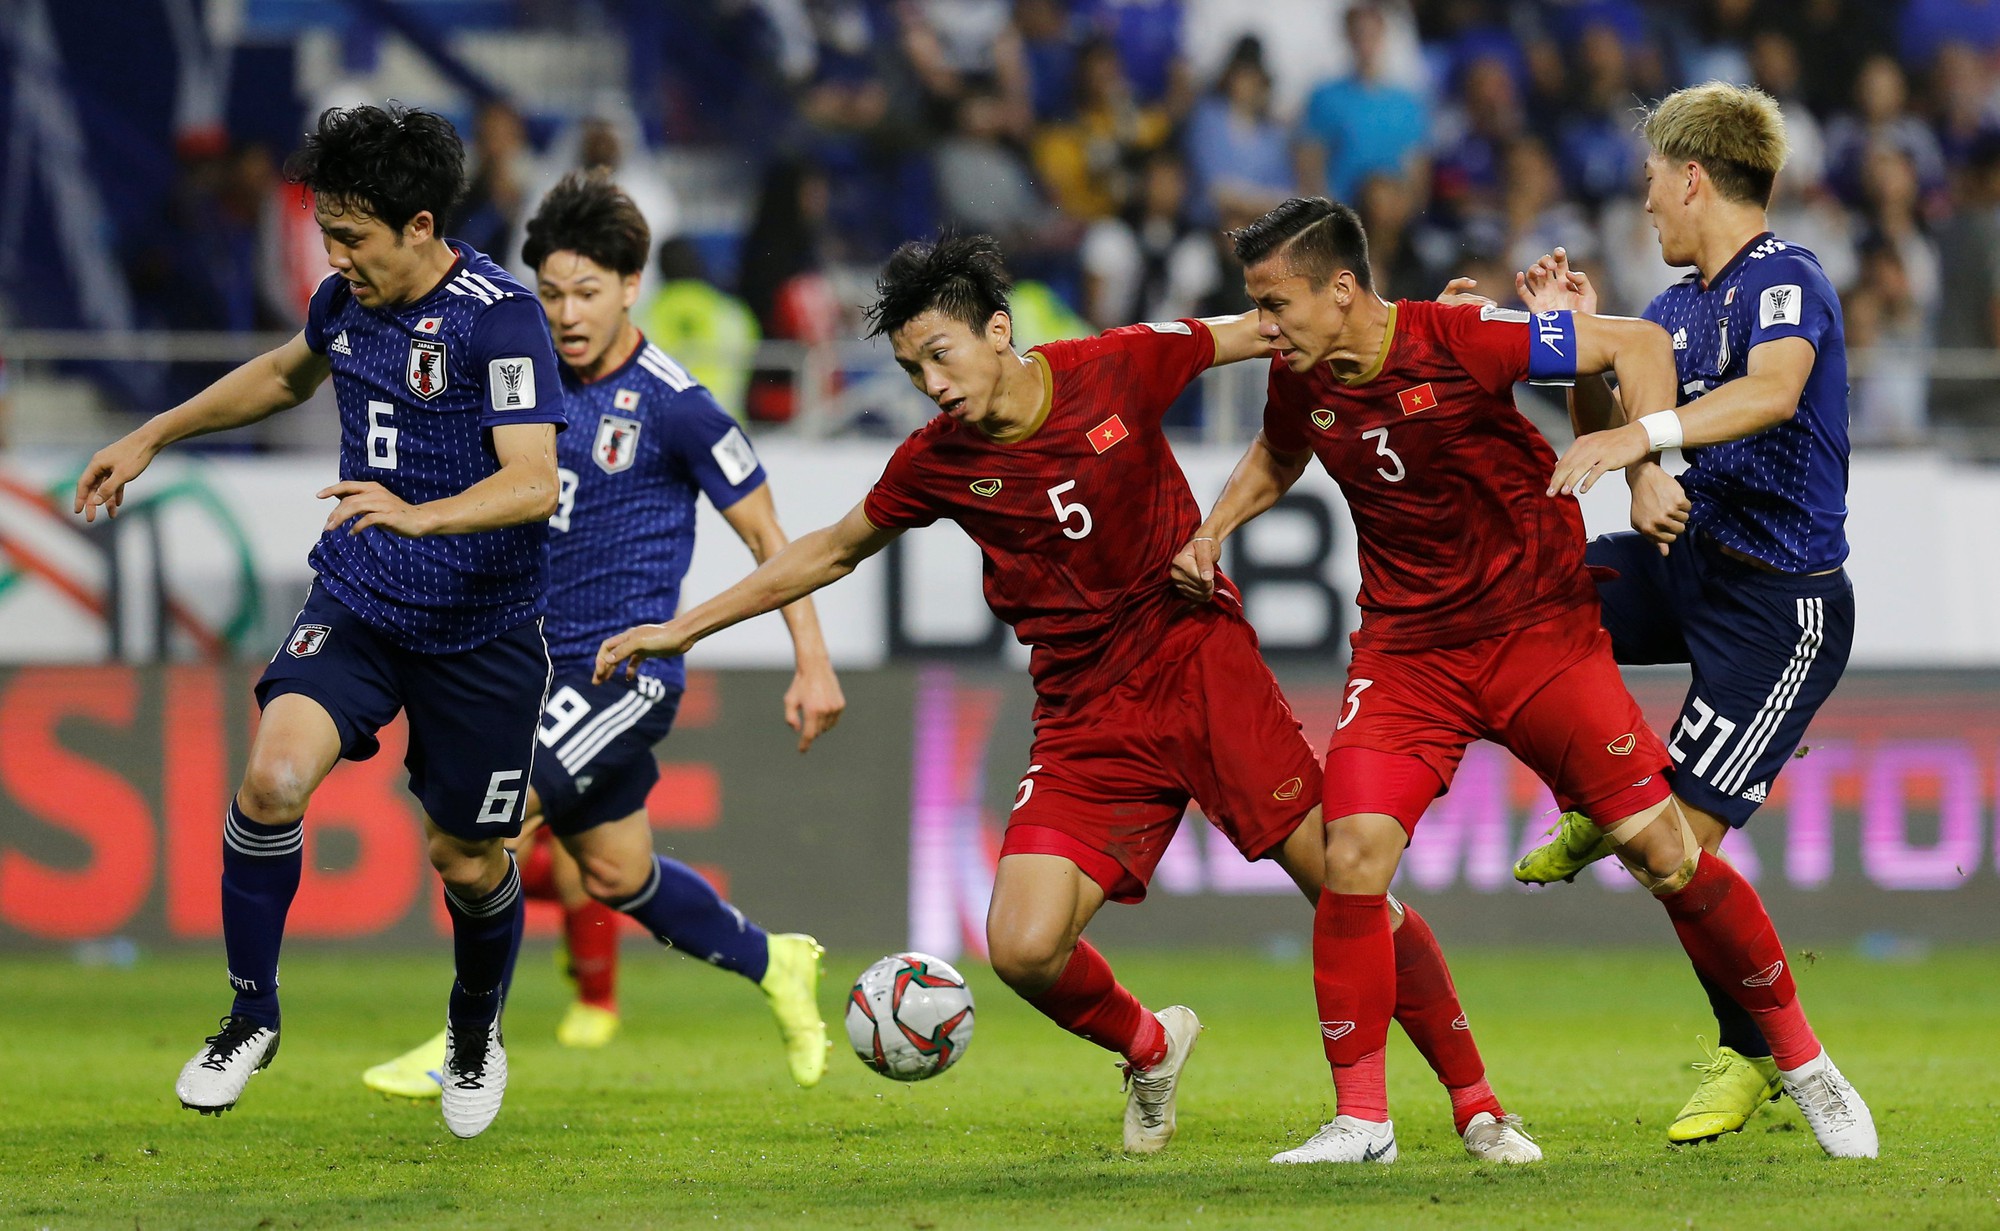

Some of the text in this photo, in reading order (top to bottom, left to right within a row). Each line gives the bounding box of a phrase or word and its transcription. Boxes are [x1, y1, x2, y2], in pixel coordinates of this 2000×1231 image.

[331, 343, 352, 356] adidas
[416, 342, 435, 350] JAPAN
[366, 400, 398, 470] 6
[1361, 427, 1406, 482] 3
[1047, 479, 1093, 540] 5
[538, 685, 592, 748] 9
[1337, 678, 1374, 730] 3
[475, 769, 523, 823] 6
